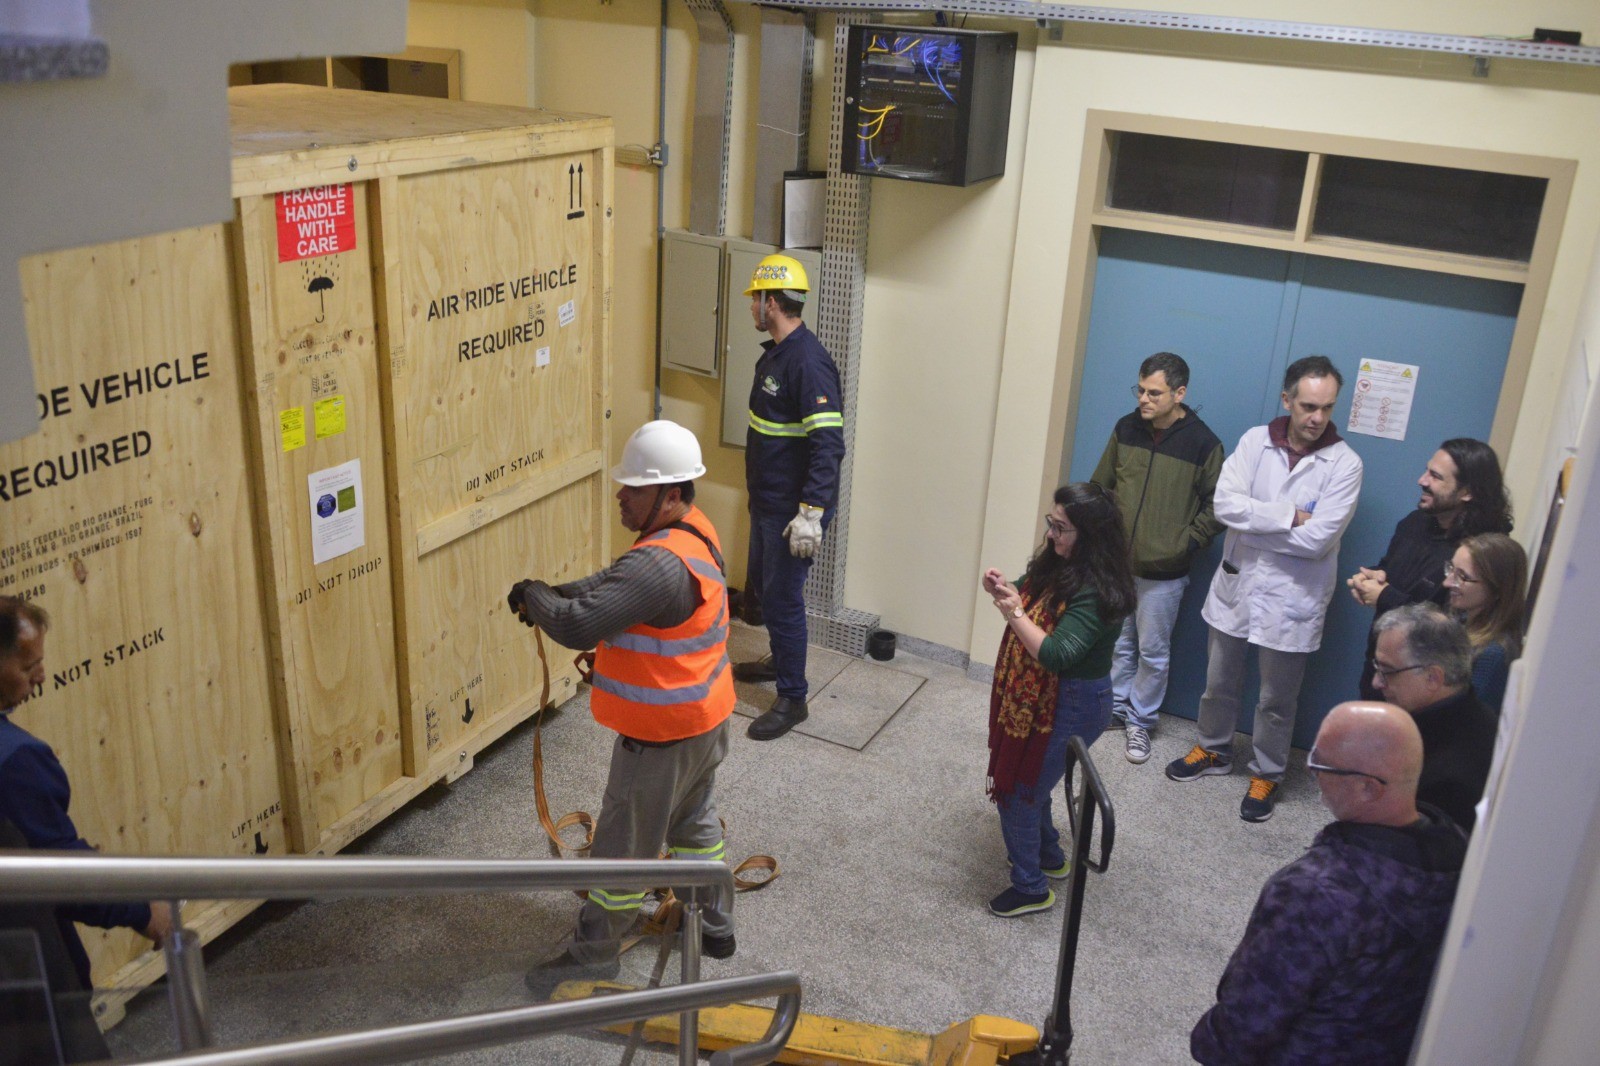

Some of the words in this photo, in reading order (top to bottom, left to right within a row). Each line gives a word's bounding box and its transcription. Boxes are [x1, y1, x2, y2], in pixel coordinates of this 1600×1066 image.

[282, 184, 346, 205] FRAGILE
[285, 199, 346, 223] HANDLE
[297, 218, 336, 239] WITH
[297, 235, 339, 257] CARE
[427, 294, 460, 322] AIR
[465, 282, 505, 312] RIDE
[509, 264, 577, 300] VEHICLE
[458, 318, 545, 363] REQUIRED
[80, 352, 210, 409] VEHICLE
[0, 430, 152, 502] REQUIRED
[466, 476, 480, 492] DO
[485, 465, 505, 484] NOT
[510, 448, 544, 472] STACK
[33, 527, 67, 546] FEDERAL
[82, 516, 96, 528] RIO
[97, 504, 127, 522] GRANDE
[62, 534, 76, 546] RIO
[115, 511, 143, 527] BRAZIL
[295, 587, 312, 605] DO
[318, 573, 343, 594] NOT
[348, 557, 382, 581] DROP
[53, 658, 92, 690] NOT
[103, 627, 166, 667] STACK
[449, 686, 465, 702] LIFT
[466, 673, 483, 691] HERE
[231, 818, 252, 839] LIFT
[256, 800, 281, 824] HERE
